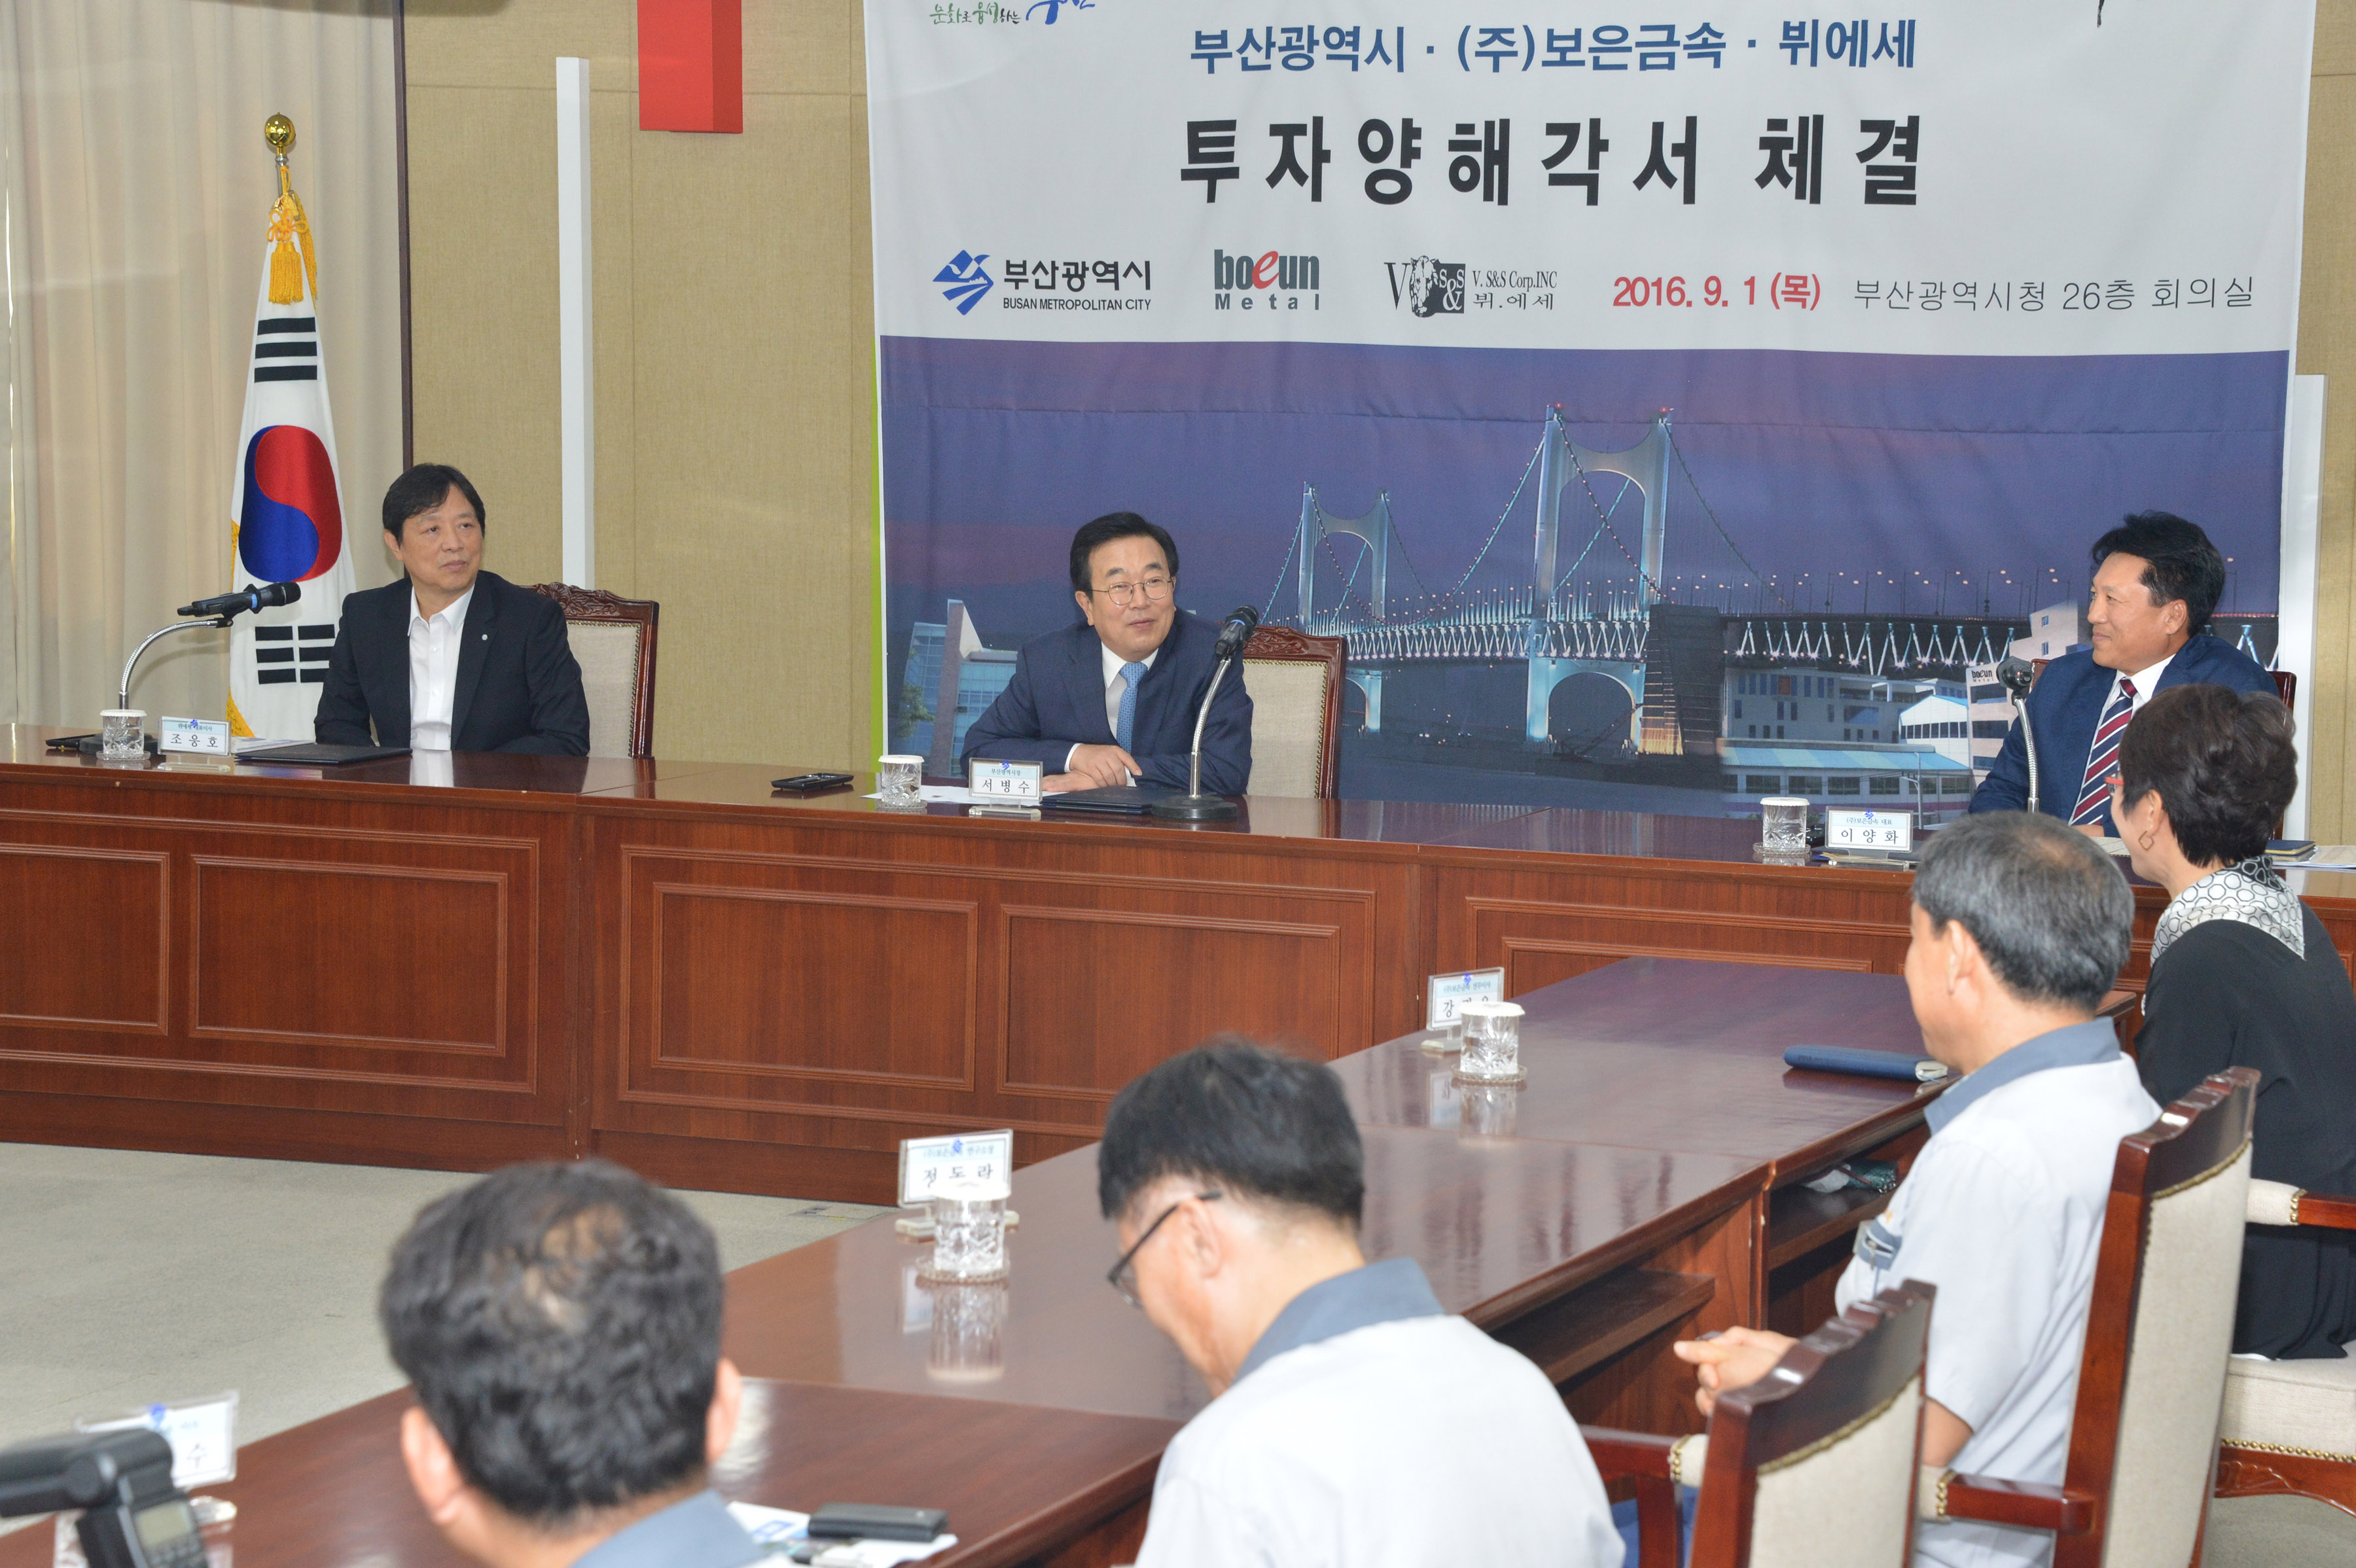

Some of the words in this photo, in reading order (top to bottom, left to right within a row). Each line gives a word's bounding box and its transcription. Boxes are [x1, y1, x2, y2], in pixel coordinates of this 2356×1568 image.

[929, 3, 971, 24] 문화로
[1190, 25, 1404, 74] 부산광역시
[1458, 22, 1726, 73] (주)보은금속
[1779, 19, 1916, 68] 뷔에세
[1181, 116, 1697, 206] 투자양해각서
[1755, 115, 1919, 205] 체결
[1004, 260, 1151, 293] 부산광역시
[1214, 249, 1319, 290] boeun
[1473, 270, 1483, 288] V.
[1486, 270, 1507, 288] S&S
[1613, 276, 1692, 307] 2016.
[1704, 276, 1728, 307] 9.
[1744, 276, 1755, 305] 1
[1771, 272, 1820, 311] (목)
[1855, 280, 2044, 312] 부산광역시청
[2063, 280, 2135, 310] 26층
[2152, 277, 2252, 309] 회의실
[1003, 298, 1037, 309] BUSAN
[1039, 298, 1122, 310] METROPOLITAN
[1125, 298, 1151, 310] CITY
[1215, 293, 1319, 310] Metal
[1971, 669, 1993, 678] boeun
[171, 734, 219, 747] 조응호
[982, 778, 1030, 794] 서병수
[1841, 828, 1899, 845] 이양화
